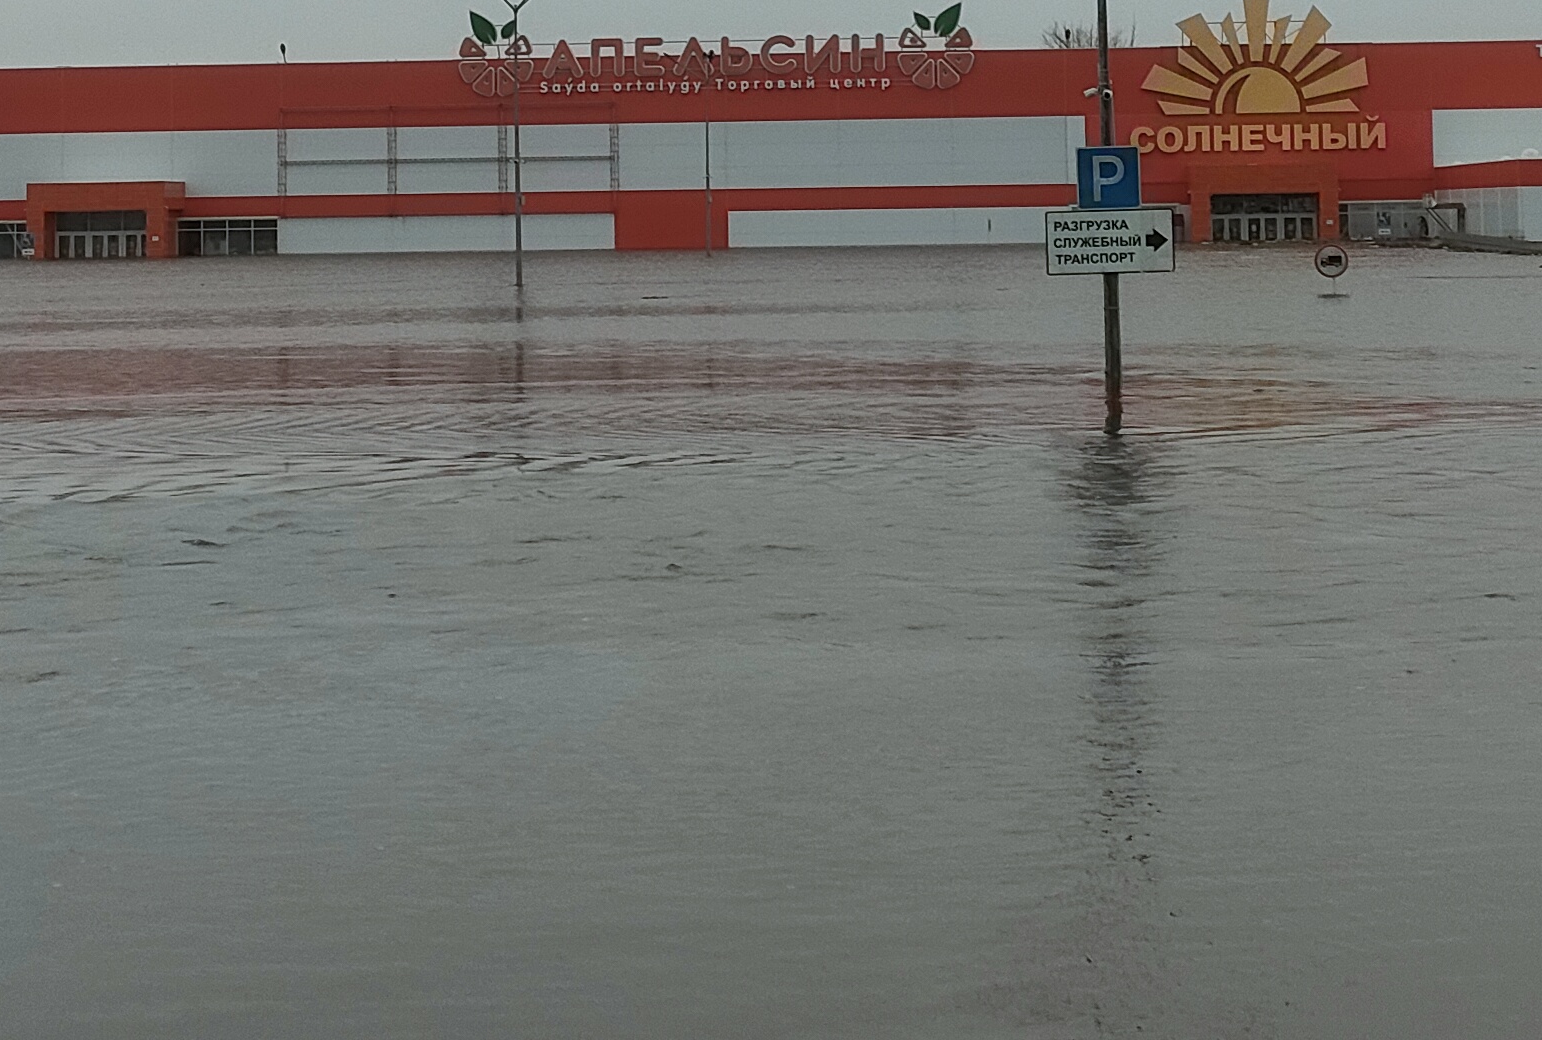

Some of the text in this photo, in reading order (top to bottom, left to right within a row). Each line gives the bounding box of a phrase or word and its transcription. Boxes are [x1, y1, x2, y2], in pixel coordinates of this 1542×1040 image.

[543, 33, 886, 79] АПЕЛЬСИН
[715, 76, 891, 93] Торговый центр
[1129, 115, 1387, 154] СОЛНЕЧНЫЙ
[1053, 220, 1129, 232] РАЗГРУЗКА
[1053, 235, 1142, 248] СЛУЖЕБНЫЙ
[1055, 252, 1136, 265] ТРАНСПОРТ
